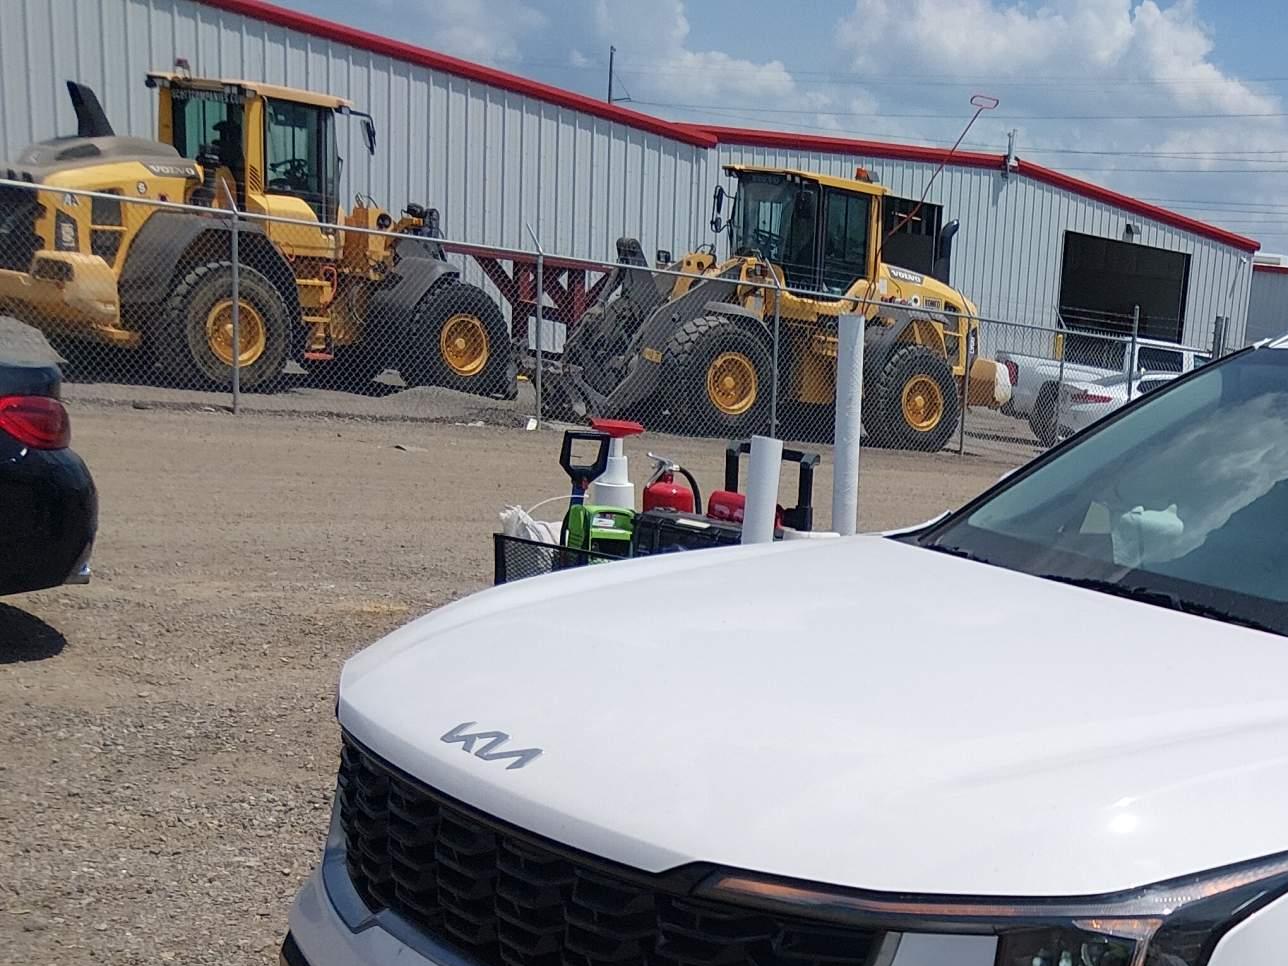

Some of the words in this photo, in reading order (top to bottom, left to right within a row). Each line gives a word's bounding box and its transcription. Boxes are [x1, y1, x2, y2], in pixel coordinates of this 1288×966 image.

[149, 164, 195, 176] VOLVO
[891, 270, 921, 283] VOLVO
[440, 721, 544, 770] KIA
